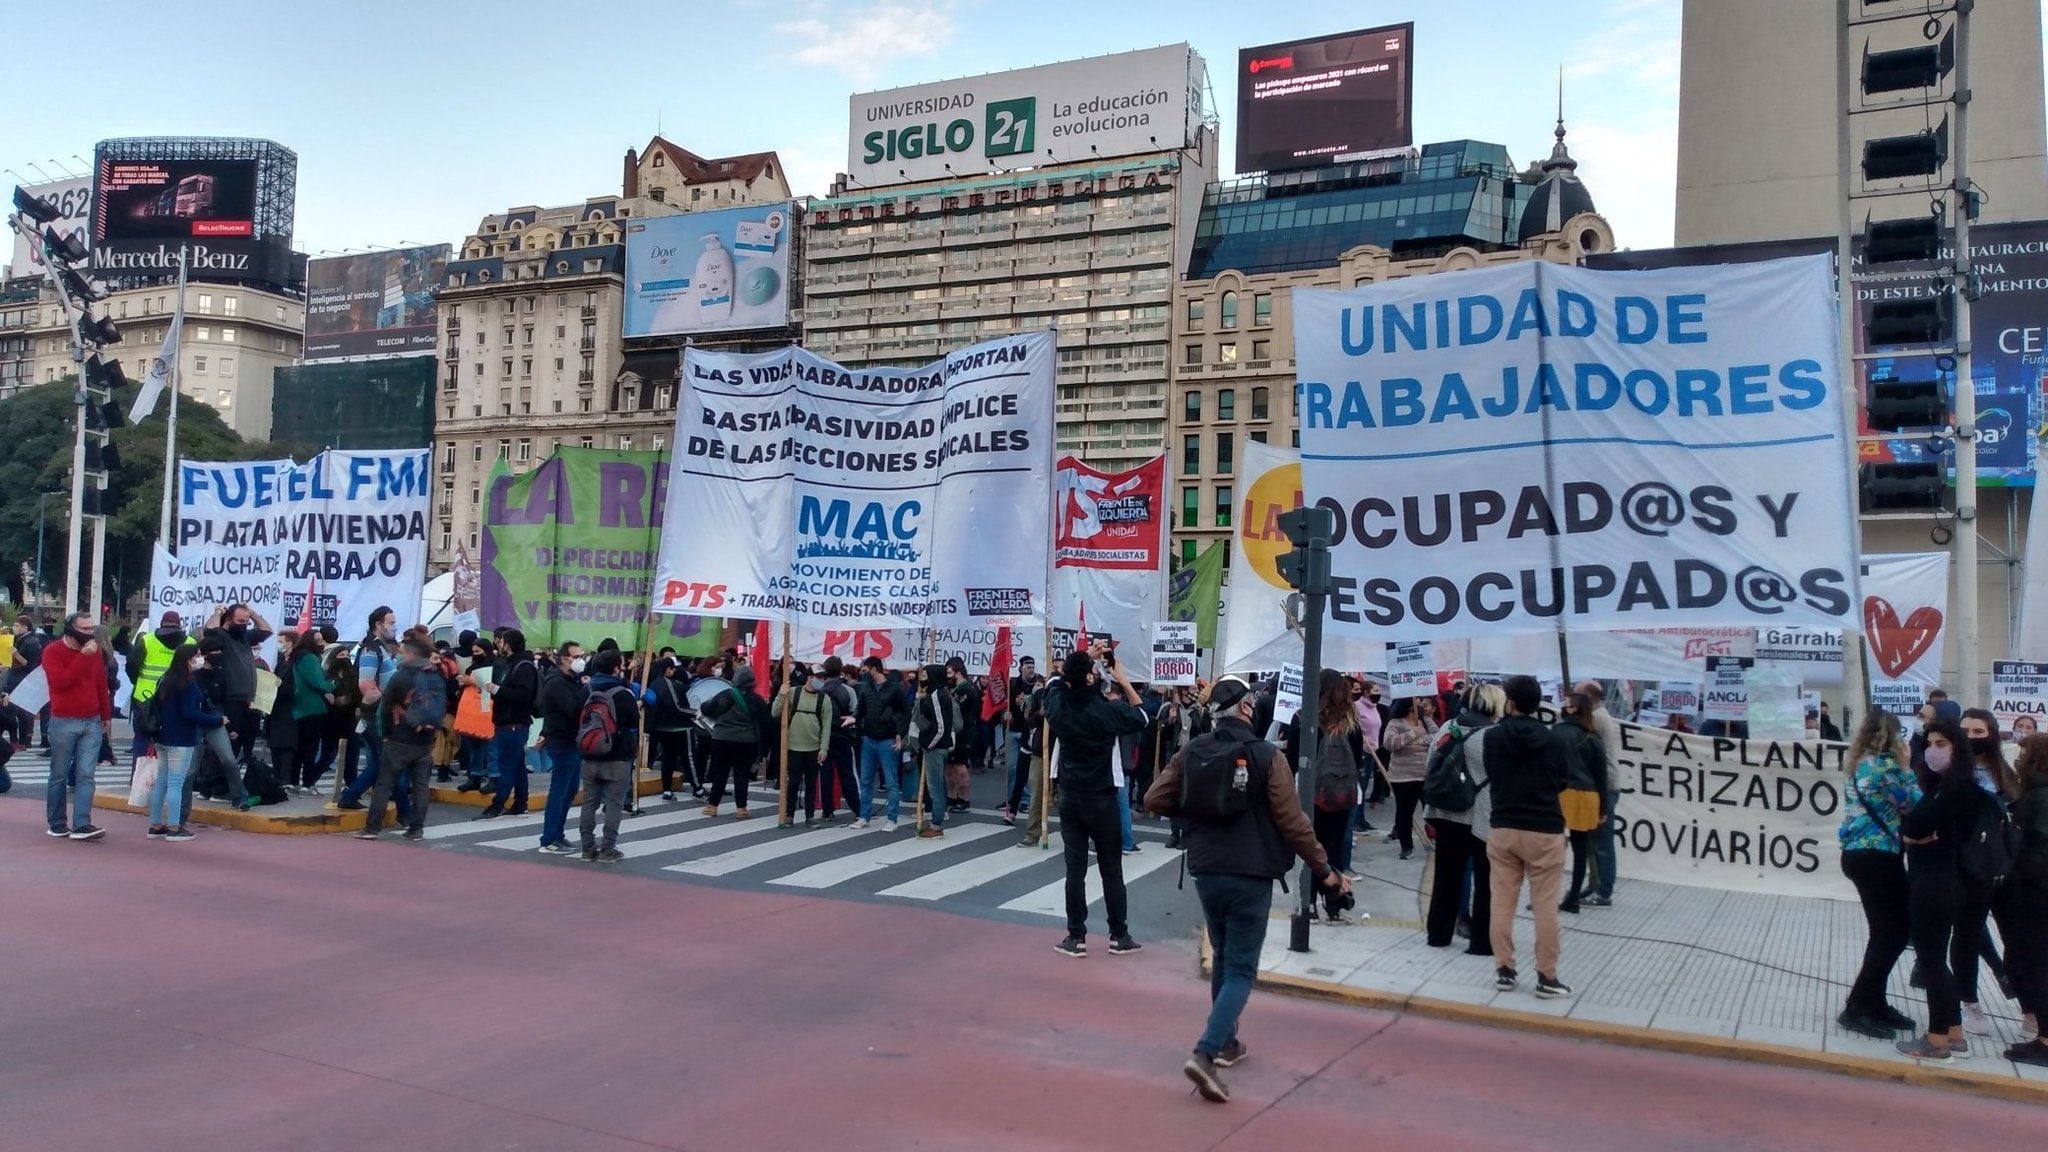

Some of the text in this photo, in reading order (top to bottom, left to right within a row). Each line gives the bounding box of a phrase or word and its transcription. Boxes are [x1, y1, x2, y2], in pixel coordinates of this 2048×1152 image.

[867, 93, 974, 122] UNIVERSIDAD
[1053, 88, 1168, 118] La educación
[1052, 110, 1150, 138] evoluciona
[863, 111, 1028, 165] SIGLO 21
[815, 201, 920, 224] HOTEL
[651, 245, 677, 259] Dove
[310, 290, 379, 305] Inteligencia al servicio
[1857, 289, 1879, 300] DE
[1884, 286, 1922, 299] ESTE
[309, 306, 318, 314] de
[326, 303, 351, 313] negocio
[1341, 287, 1708, 357] UNIDAD DE
[376, 337, 405, 347] TELECOM
[695, 364, 743, 385] LAS
[796, 361, 946, 394] RABAJADORA
[702, 406, 781, 432] BASTA
[795, 408, 935, 441] PASIVIDAD
[687, 435, 777, 464] DE LAS
[347, 456, 428, 500] FMI
[488, 457, 575, 526] LA
[1098, 496, 1144, 509] FRENTE DE
[800, 497, 921, 540] MAC
[1099, 507, 1149, 521] IZQUIERDA
[1315, 480, 1799, 549] OCUPAD@S Y
[180, 518, 268, 548] PLATA
[291, 511, 426, 545] VIVIENDA
[1106, 525, 1137, 537] UNIDAD
[286, 546, 402, 581] RABAJO
[1097, 551, 1145, 560] SOCIALISTAS
[204, 556, 263, 575] LUCHA
[790, 563, 931, 581] MOVIMIENTO DE
[662, 580, 727, 609] PTS
[968, 589, 1028, 600] FRENTE DE
[1326, 557, 1851, 627] ESOCUPAD@S
[322, 596, 335, 607] DE
[524, 600, 540, 619] Y
[812, 600, 887, 617] CLASISTAS
[968, 599, 1031, 611] IZQUIERDA
[985, 617, 1016, 625] UNIDAD
[1658, 626, 1751, 638] Antiburocrática
[1154, 662, 1194, 675] BORDO
[1391, 677, 1413, 686] SALUD
[1874, 684, 1903, 693] Esencial
[1913, 684, 1920, 693] la
[1993, 675, 2048, 685] Basta de tregua
[2004, 685, 2039, 695] y entrega
[1872, 695, 1900, 703] Primera
[1993, 700, 2047, 714] ANCLA
[1663, 732, 1850, 772] A PLANT
